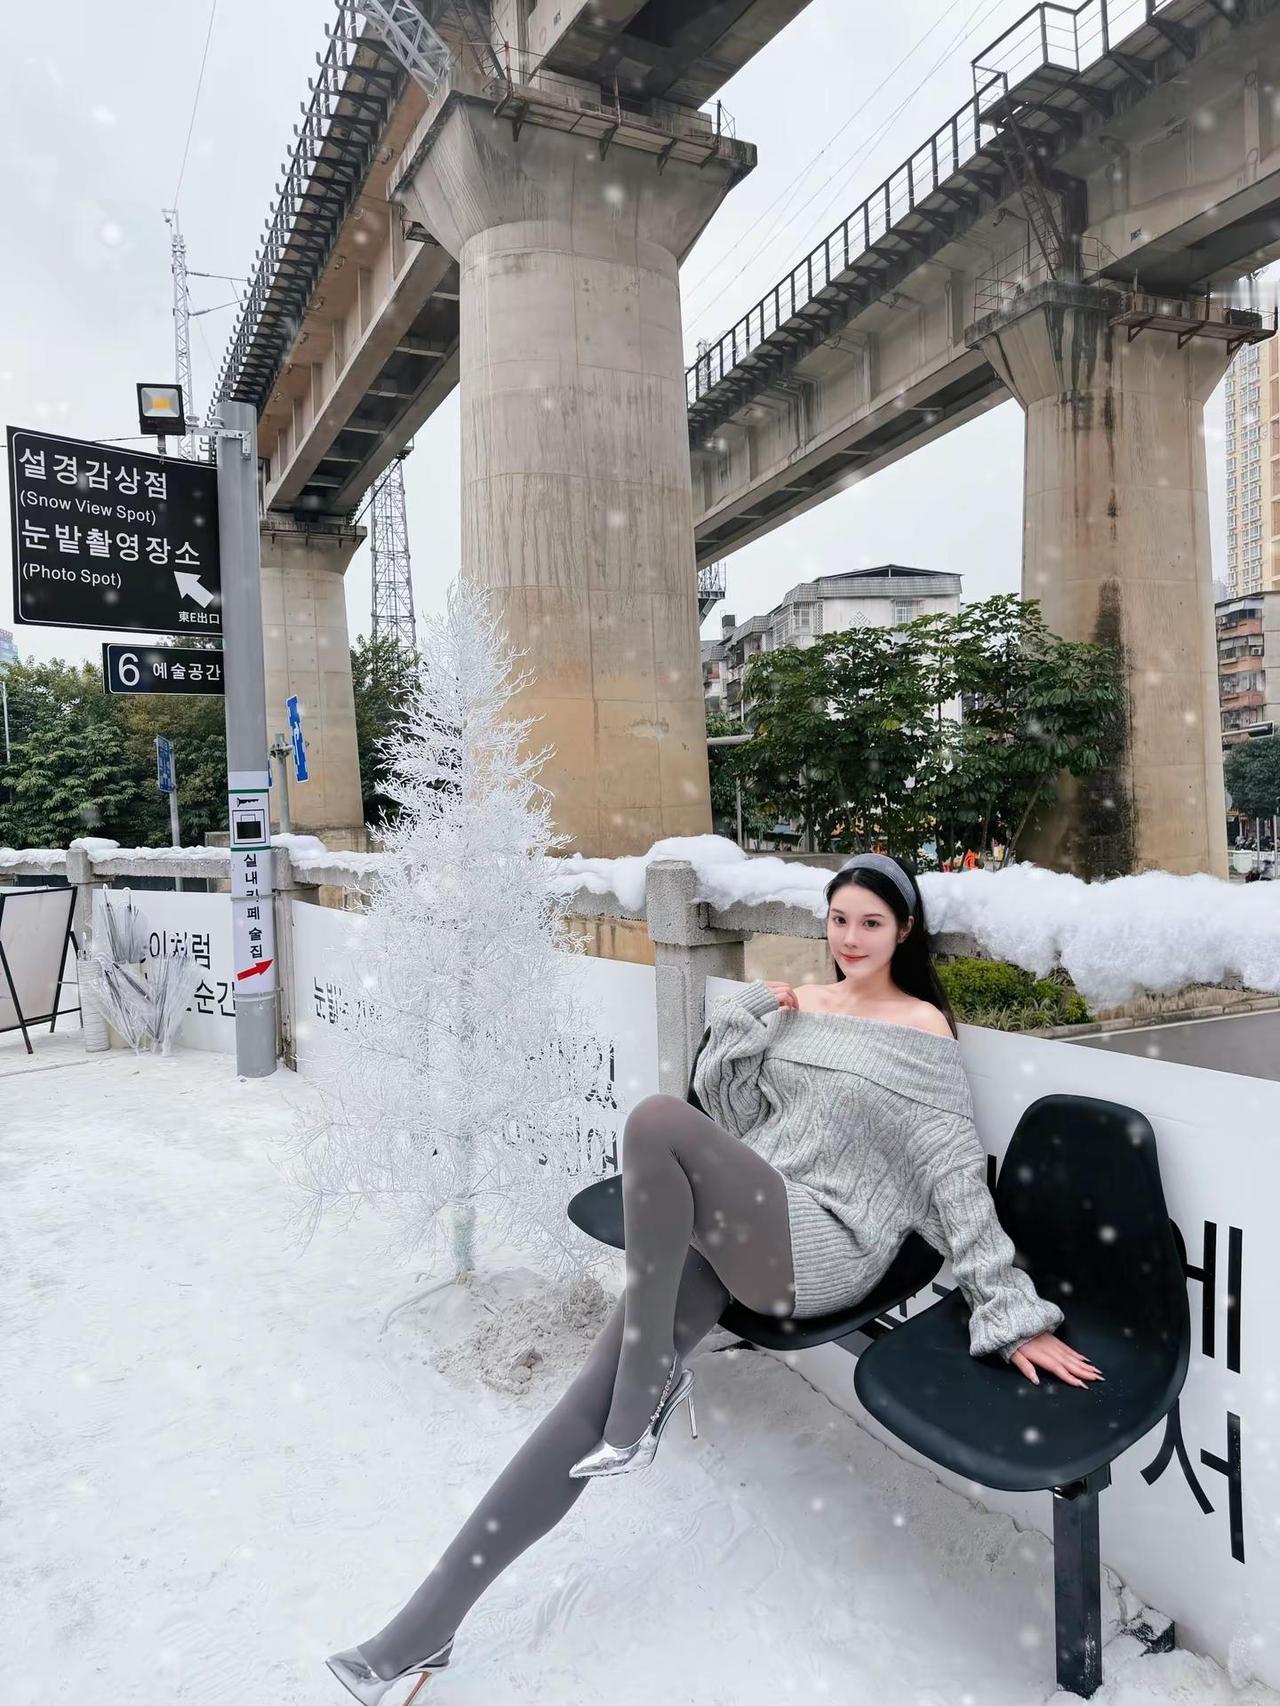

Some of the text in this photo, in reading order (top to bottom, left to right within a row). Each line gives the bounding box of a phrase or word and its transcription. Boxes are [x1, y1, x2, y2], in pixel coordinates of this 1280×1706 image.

[19, 448, 167, 500] 설경감상점
[20, 489, 157, 526] (Snow View Spot)
[22, 561, 122, 588] (Photo Spot)
[118, 652, 140, 686] 6
[152, 662, 222, 681] 예술공간
